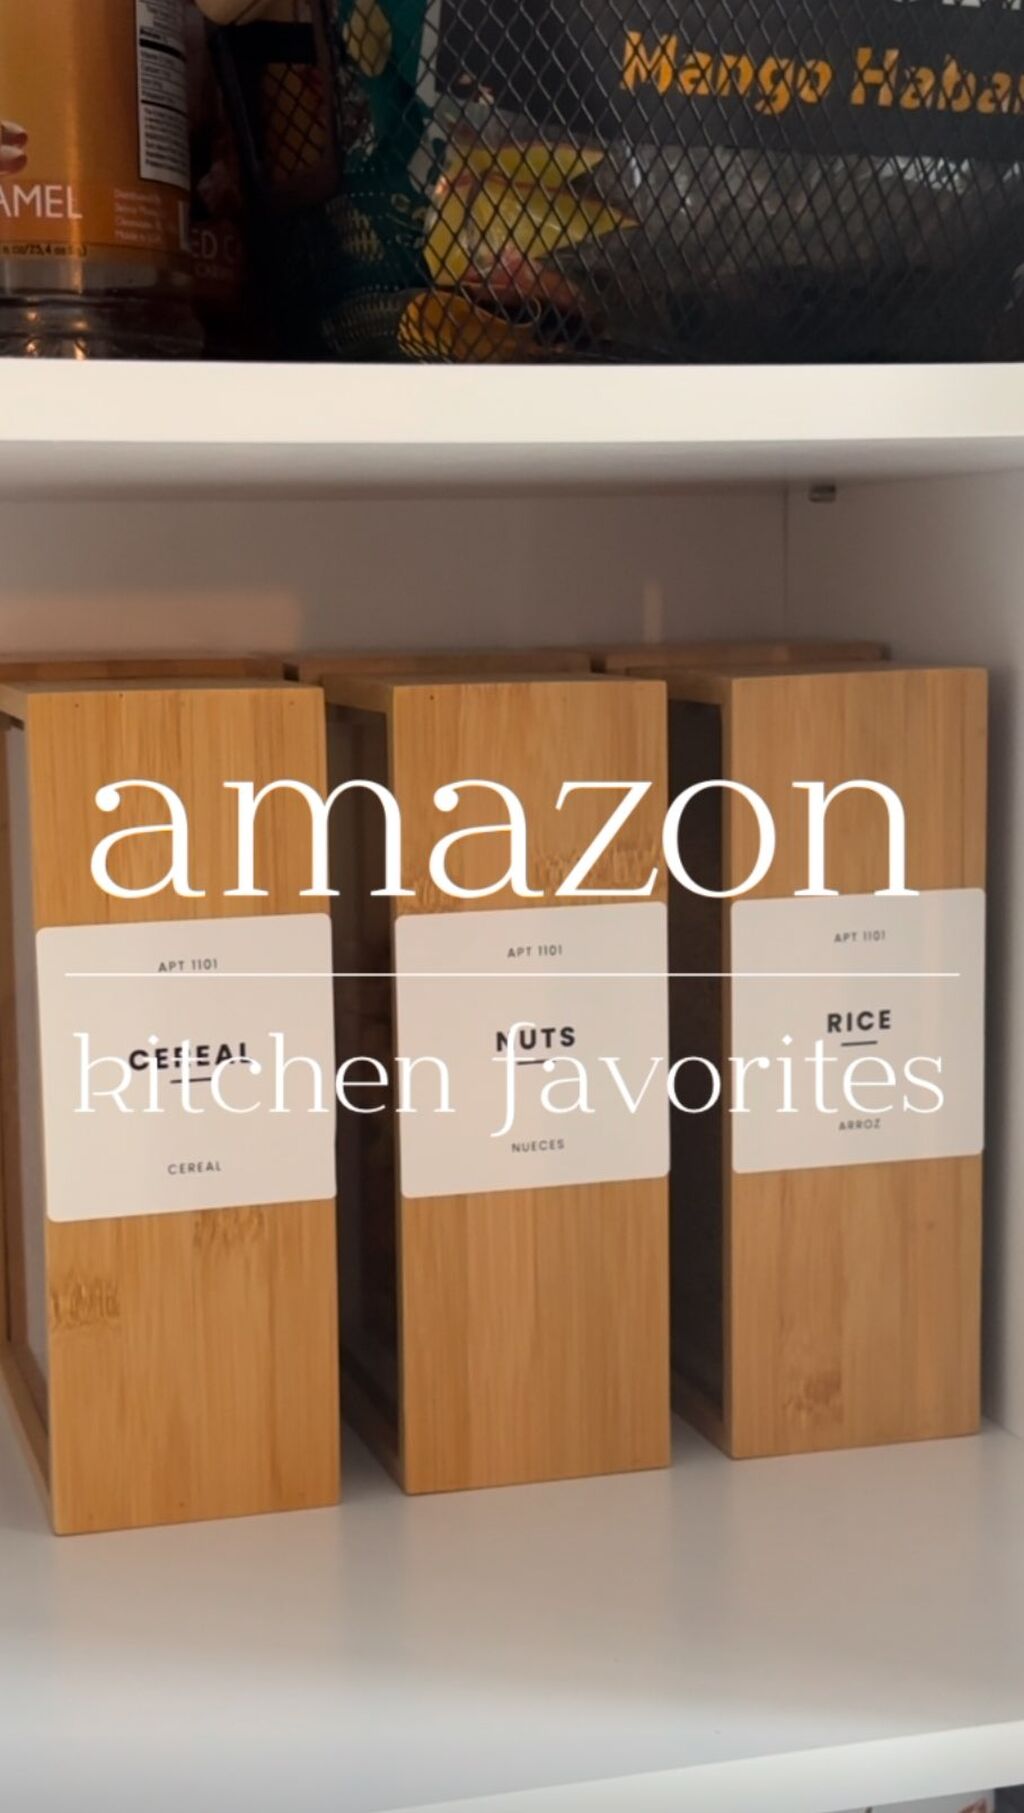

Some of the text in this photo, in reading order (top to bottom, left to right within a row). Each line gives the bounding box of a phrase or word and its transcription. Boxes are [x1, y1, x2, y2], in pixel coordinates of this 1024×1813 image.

[620, 30, 834, 115] Mango
[833, 930, 886, 944] APT 1101
[507, 944, 563, 959] APT 1101
[157, 958, 218, 973] APT 1101
[826, 1009, 892, 1034] RICE
[496, 1026, 576, 1052] NUTS
[838, 1118, 881, 1131] ARROZ
[511, 1138, 565, 1154] NUECES
[167, 1160, 222, 1176] CEREAL
